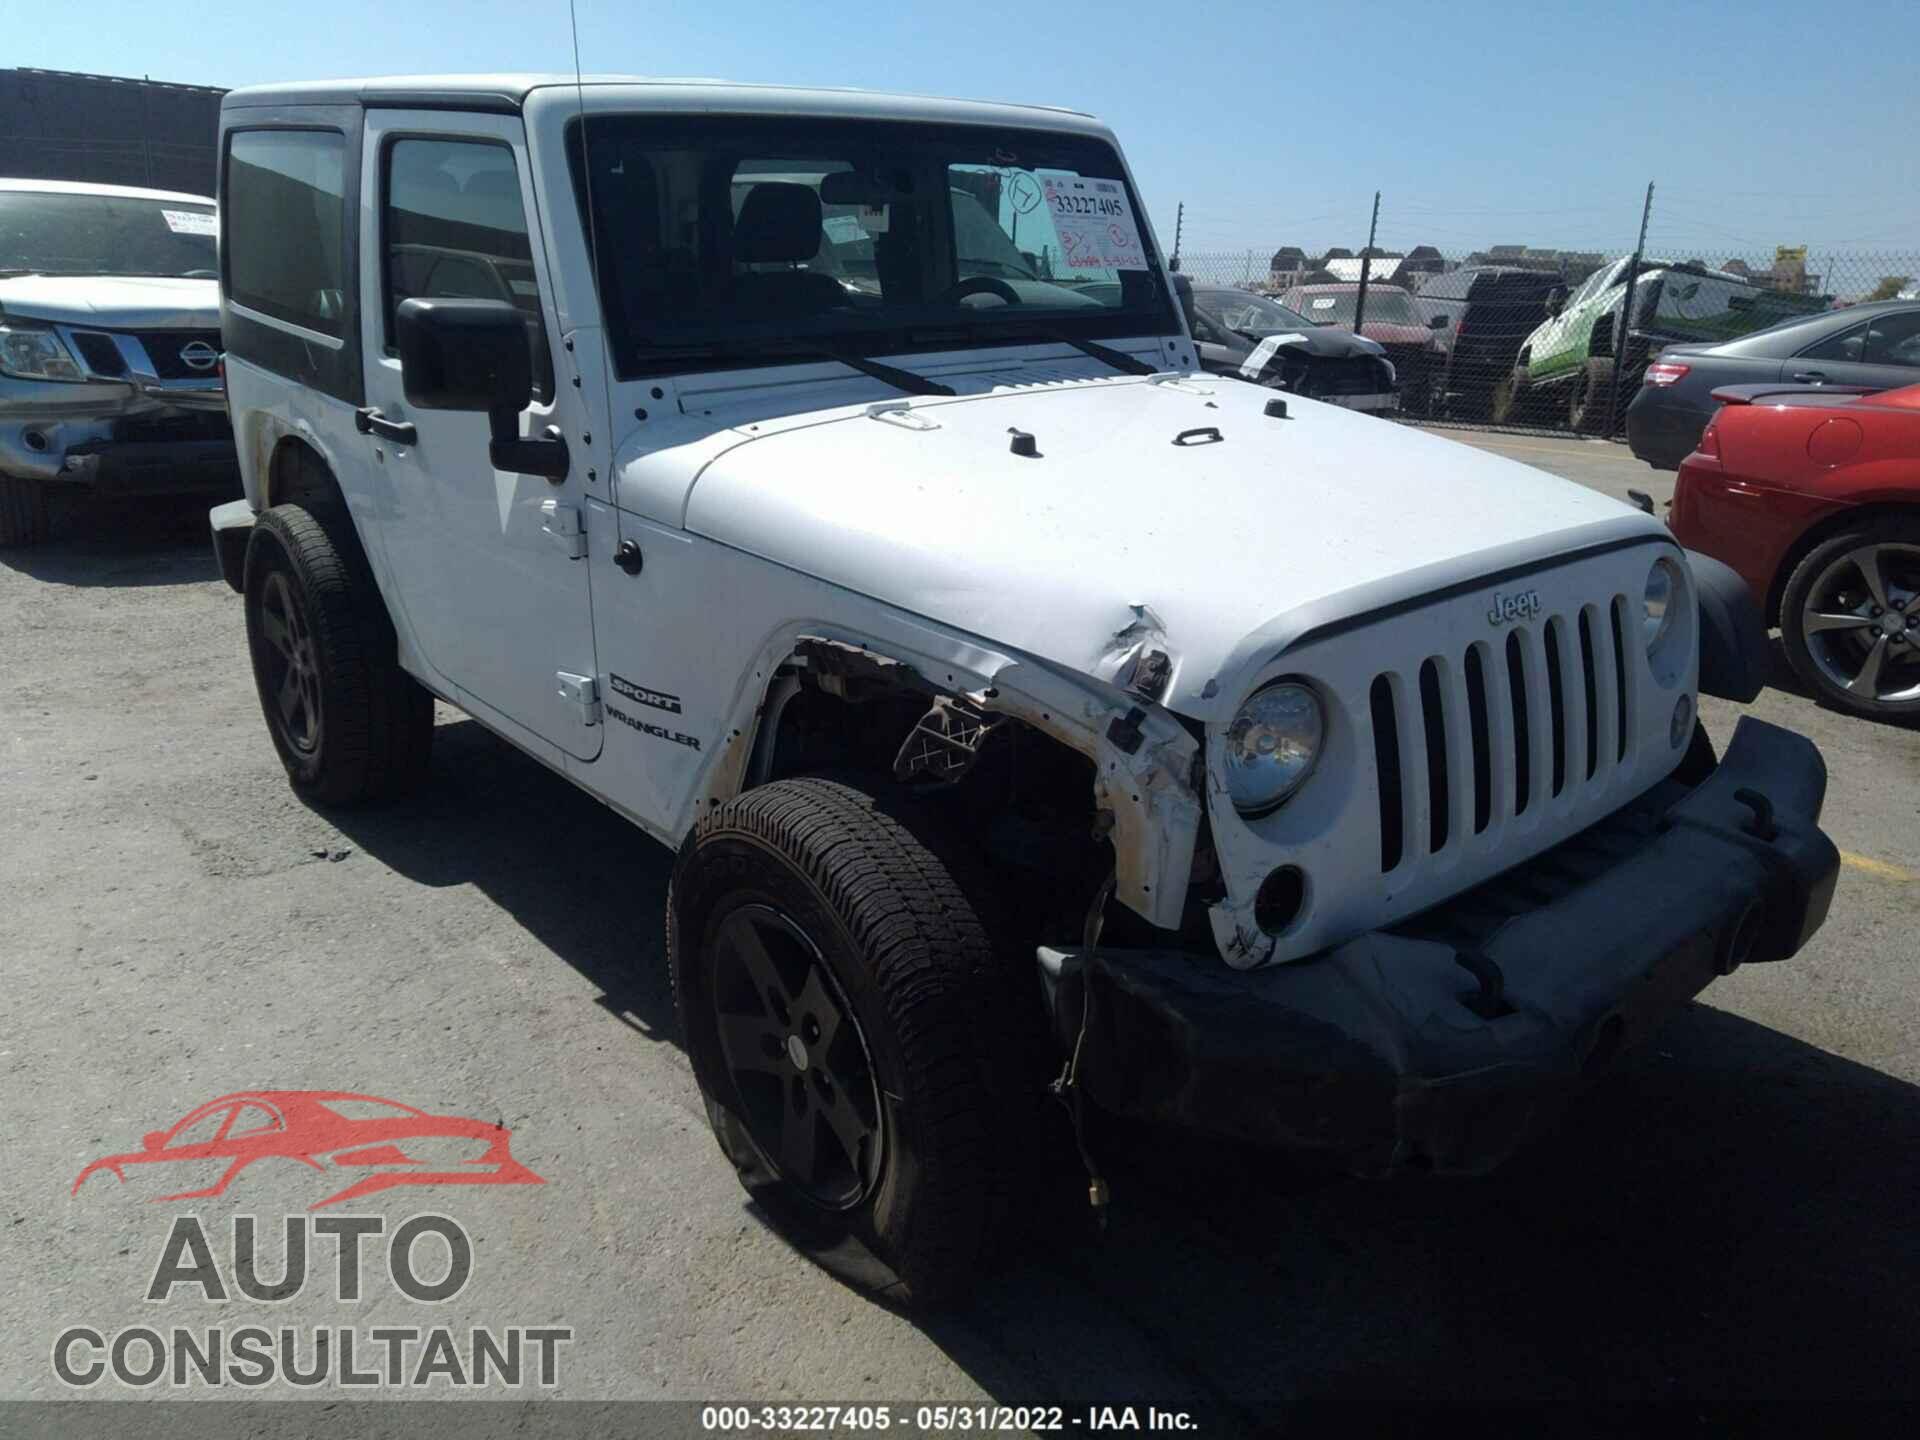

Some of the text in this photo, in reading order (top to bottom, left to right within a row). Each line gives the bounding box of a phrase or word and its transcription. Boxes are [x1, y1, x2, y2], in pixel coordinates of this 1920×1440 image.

[1055, 194, 1123, 217] 33227405
[1488, 591, 1540, 626] Jeep
[611, 678, 674, 708] SPORT
[605, 704, 701, 751] WRANGLER
